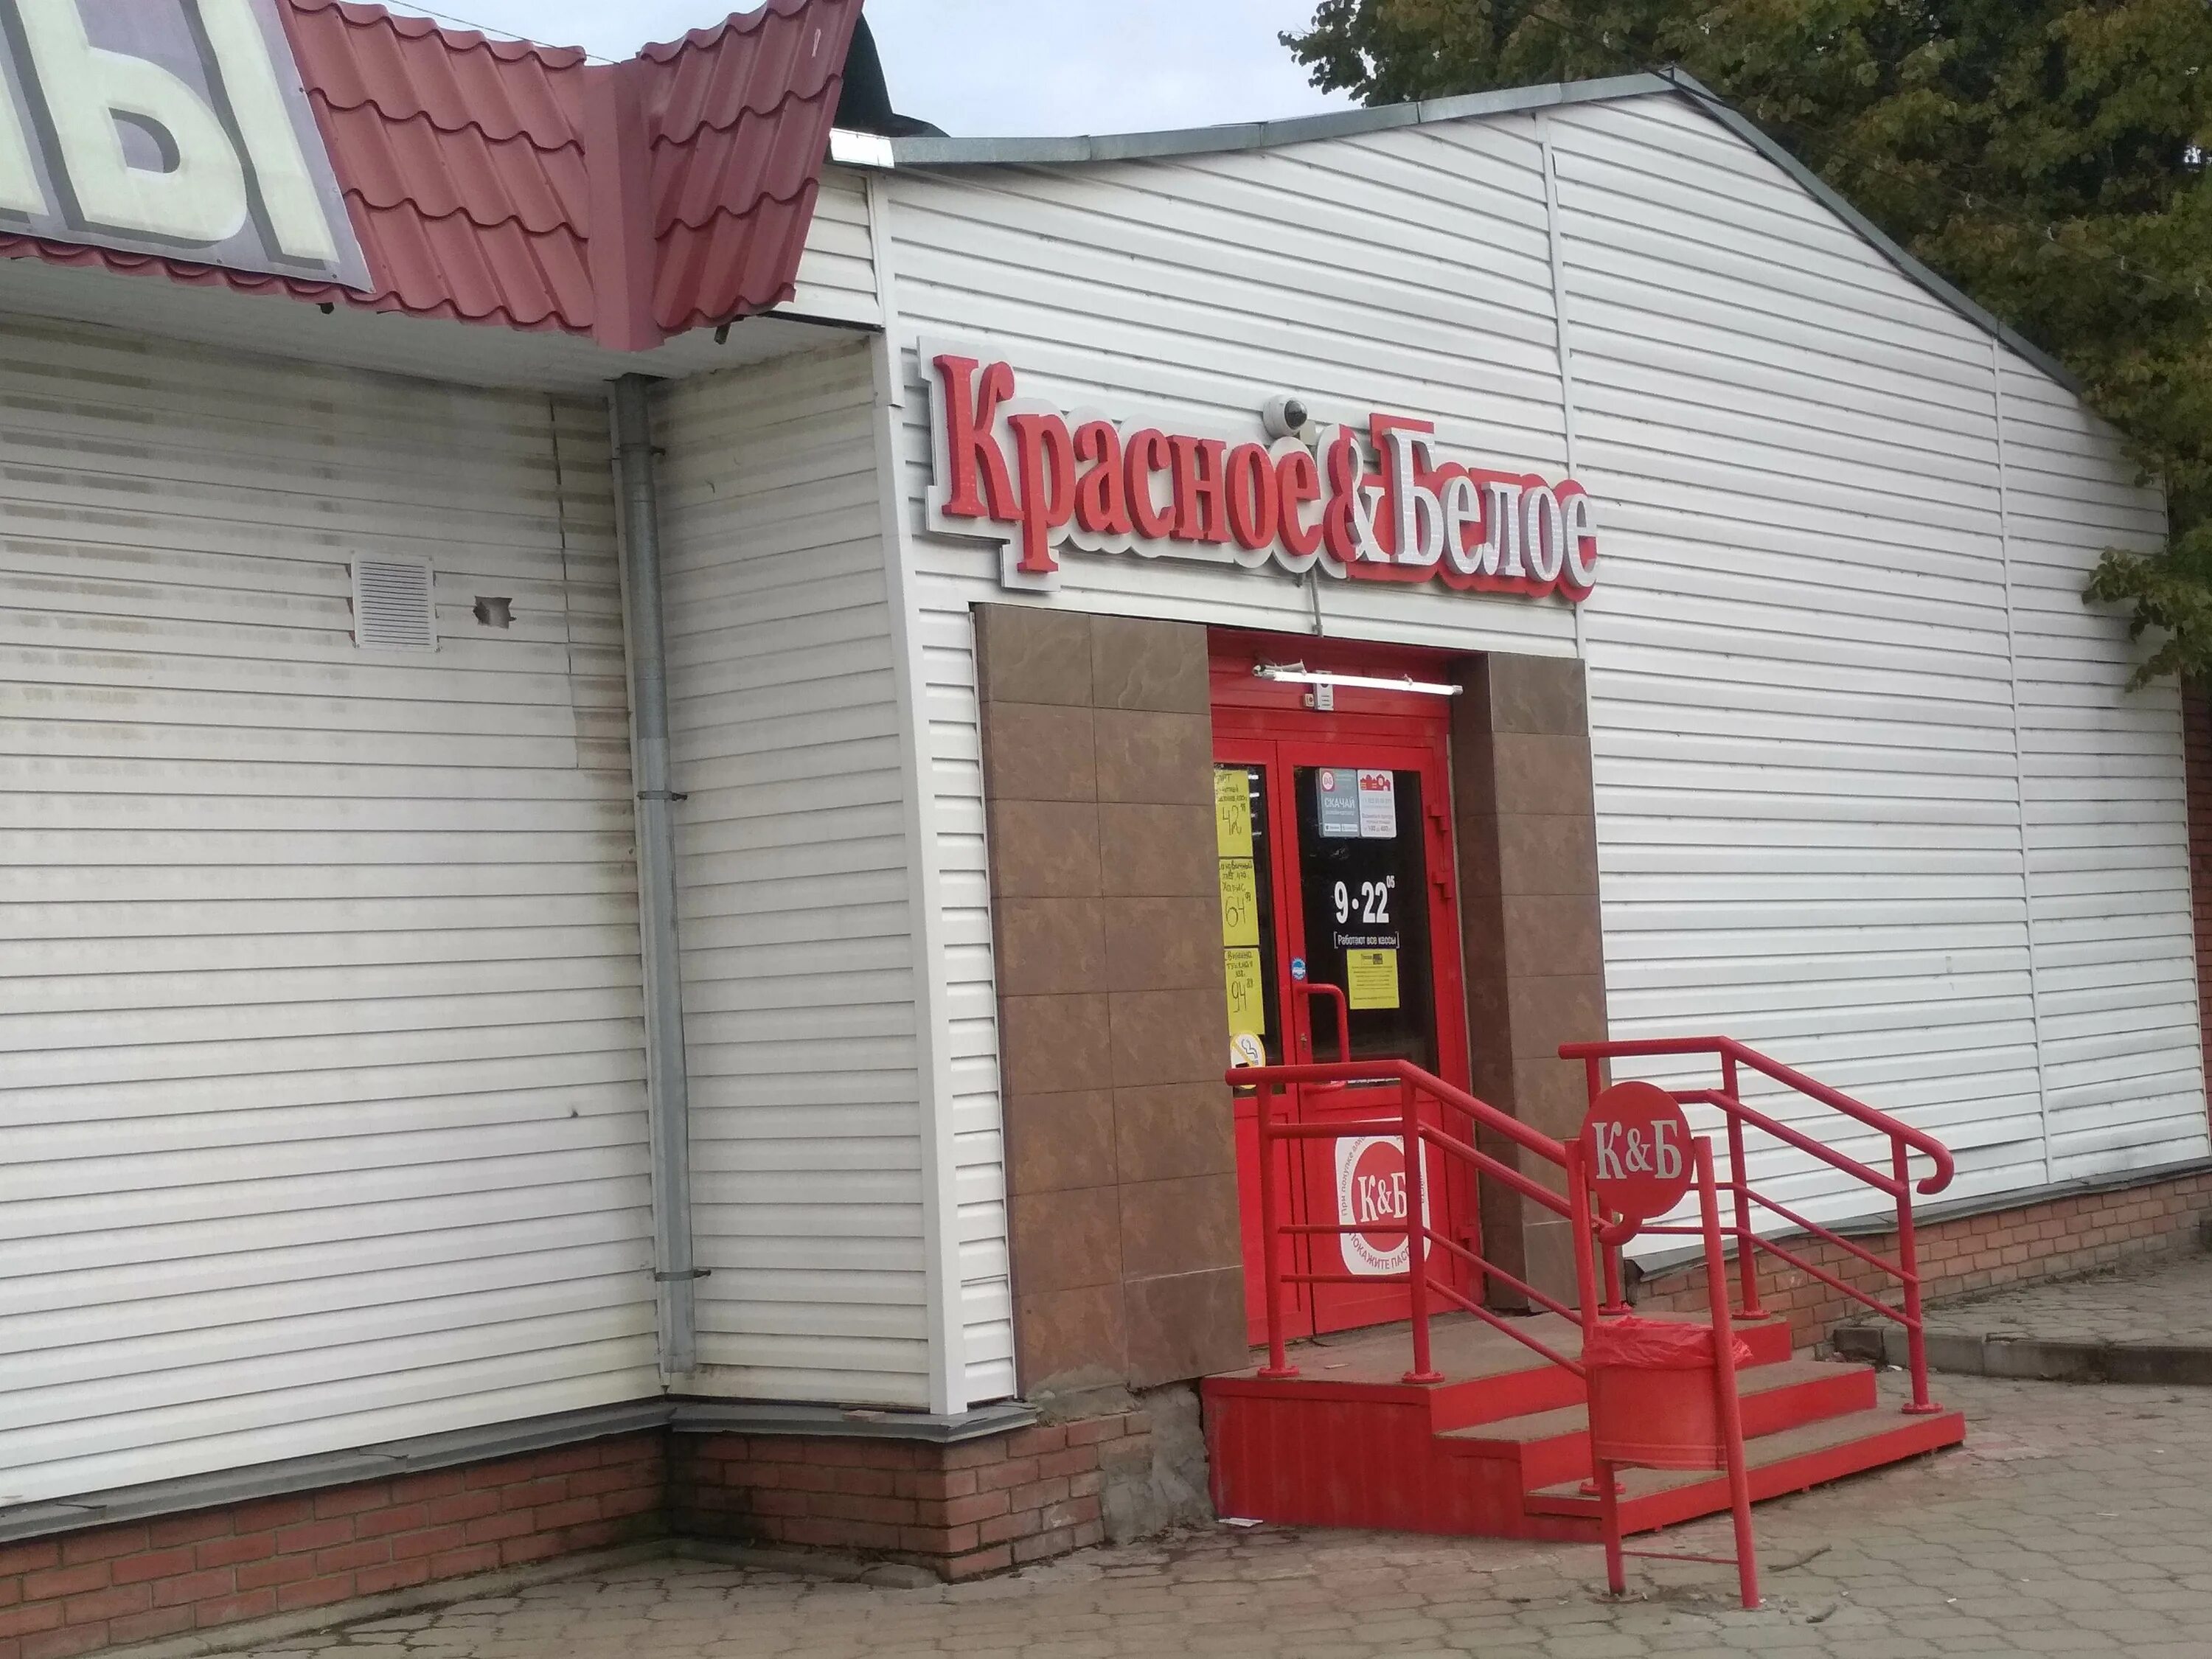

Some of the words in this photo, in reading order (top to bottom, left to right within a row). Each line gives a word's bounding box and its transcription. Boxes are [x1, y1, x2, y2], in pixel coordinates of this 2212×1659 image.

[0, 0, 339, 262] Ы
[1324, 796, 1355, 809] СКАЧАЙ
[1592, 1119, 1682, 1180] К&Б
